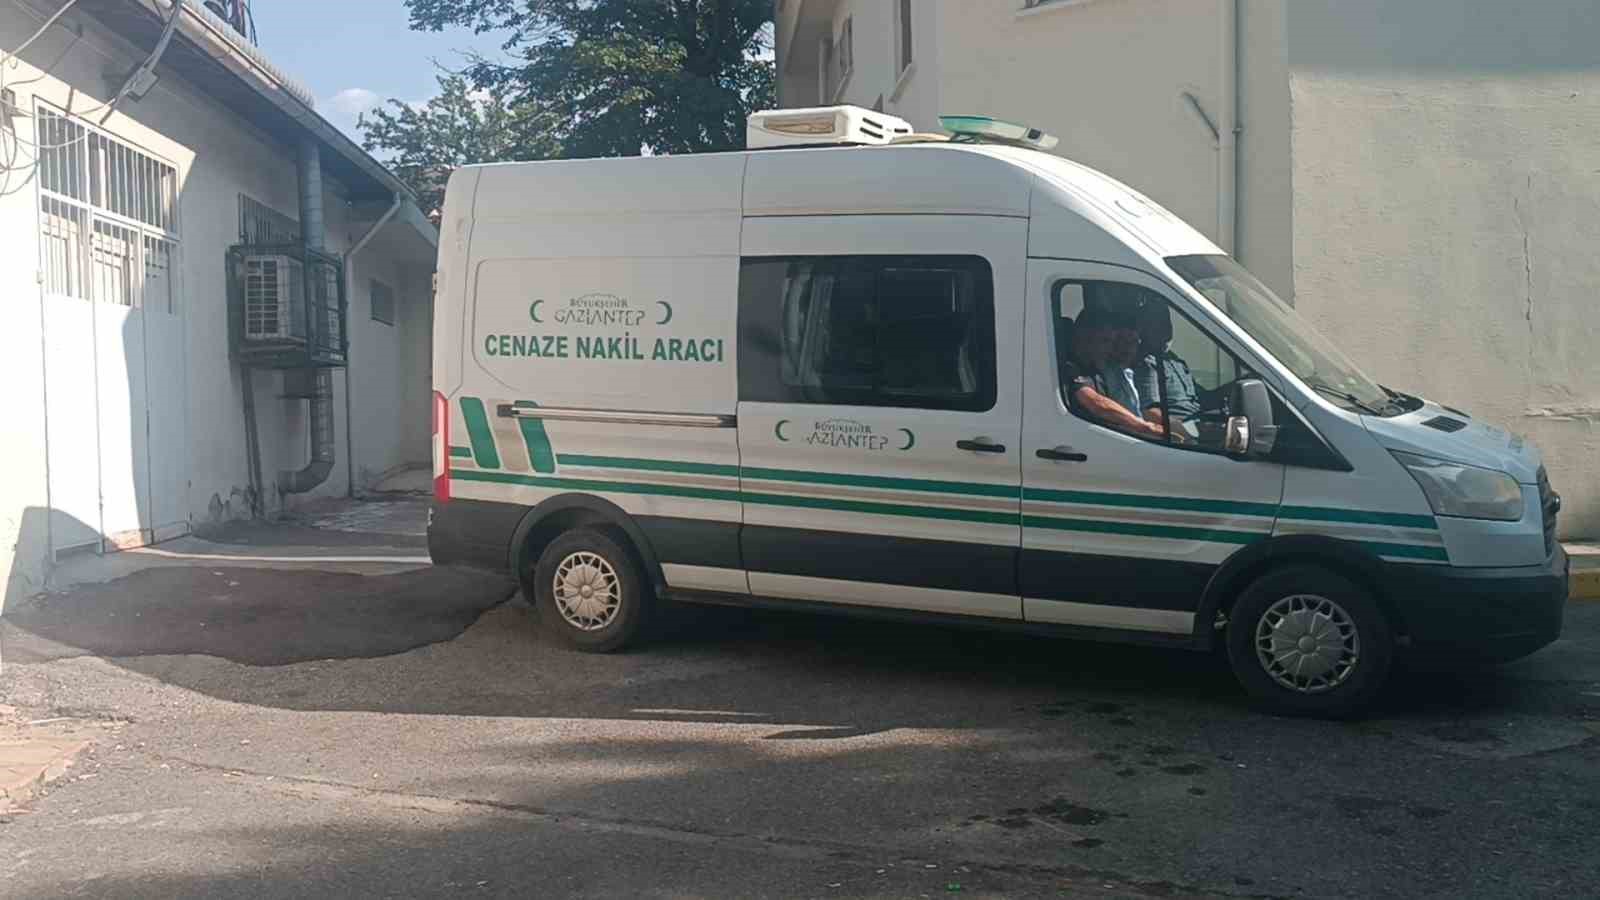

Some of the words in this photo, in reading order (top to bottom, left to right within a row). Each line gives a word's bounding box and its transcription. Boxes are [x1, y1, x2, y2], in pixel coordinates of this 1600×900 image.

[485, 334, 568, 357] CENAZE
[576, 332, 644, 360] NAKİL
[652, 338, 723, 362] ARACI
